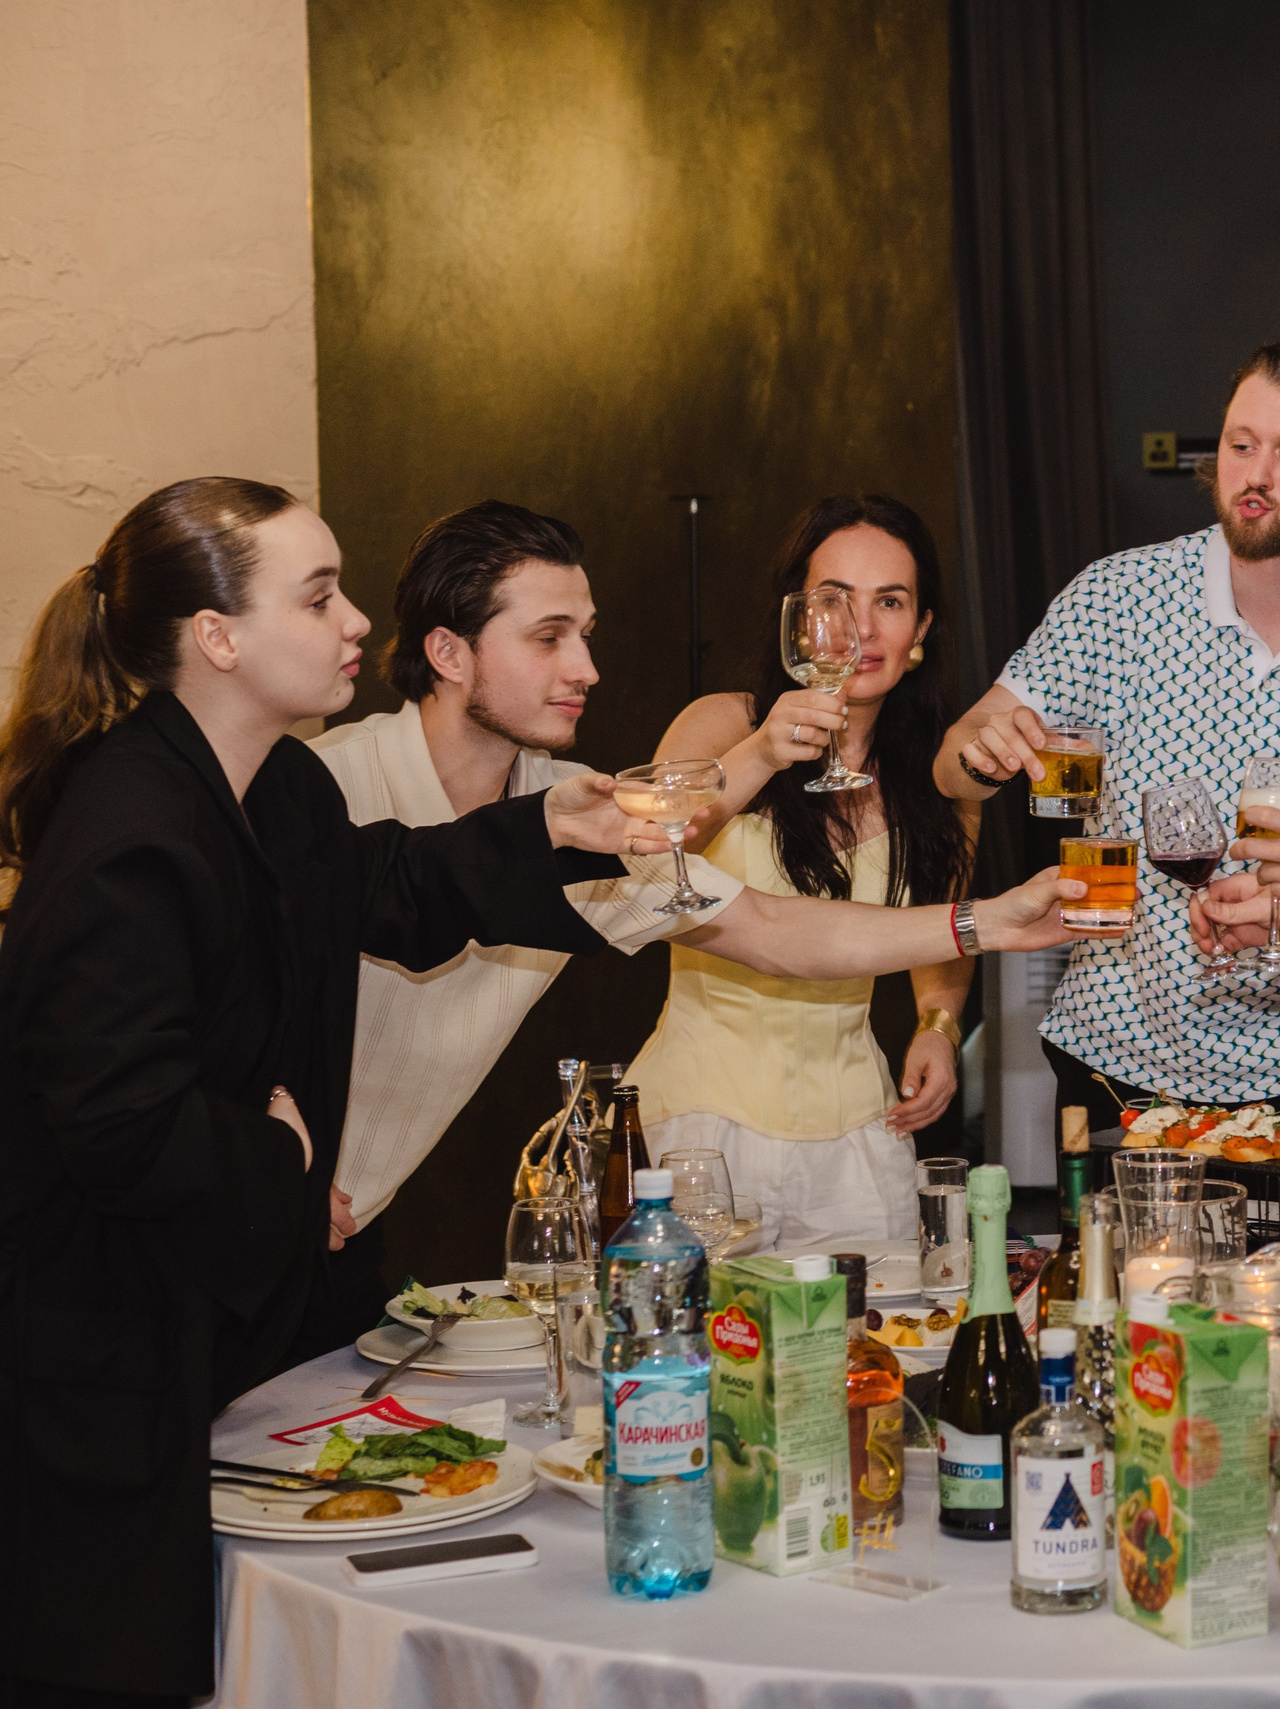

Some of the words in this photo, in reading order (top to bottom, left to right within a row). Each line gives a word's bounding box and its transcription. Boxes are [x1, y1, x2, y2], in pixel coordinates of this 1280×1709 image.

[719, 1373, 754, 1392] ЯБЛОКО
[618, 1418, 707, 1445] КАРАЧИНСКАЯ
[859, 1418, 902, 1502] 5
[1033, 1537, 1098, 1555] TUNDRA
